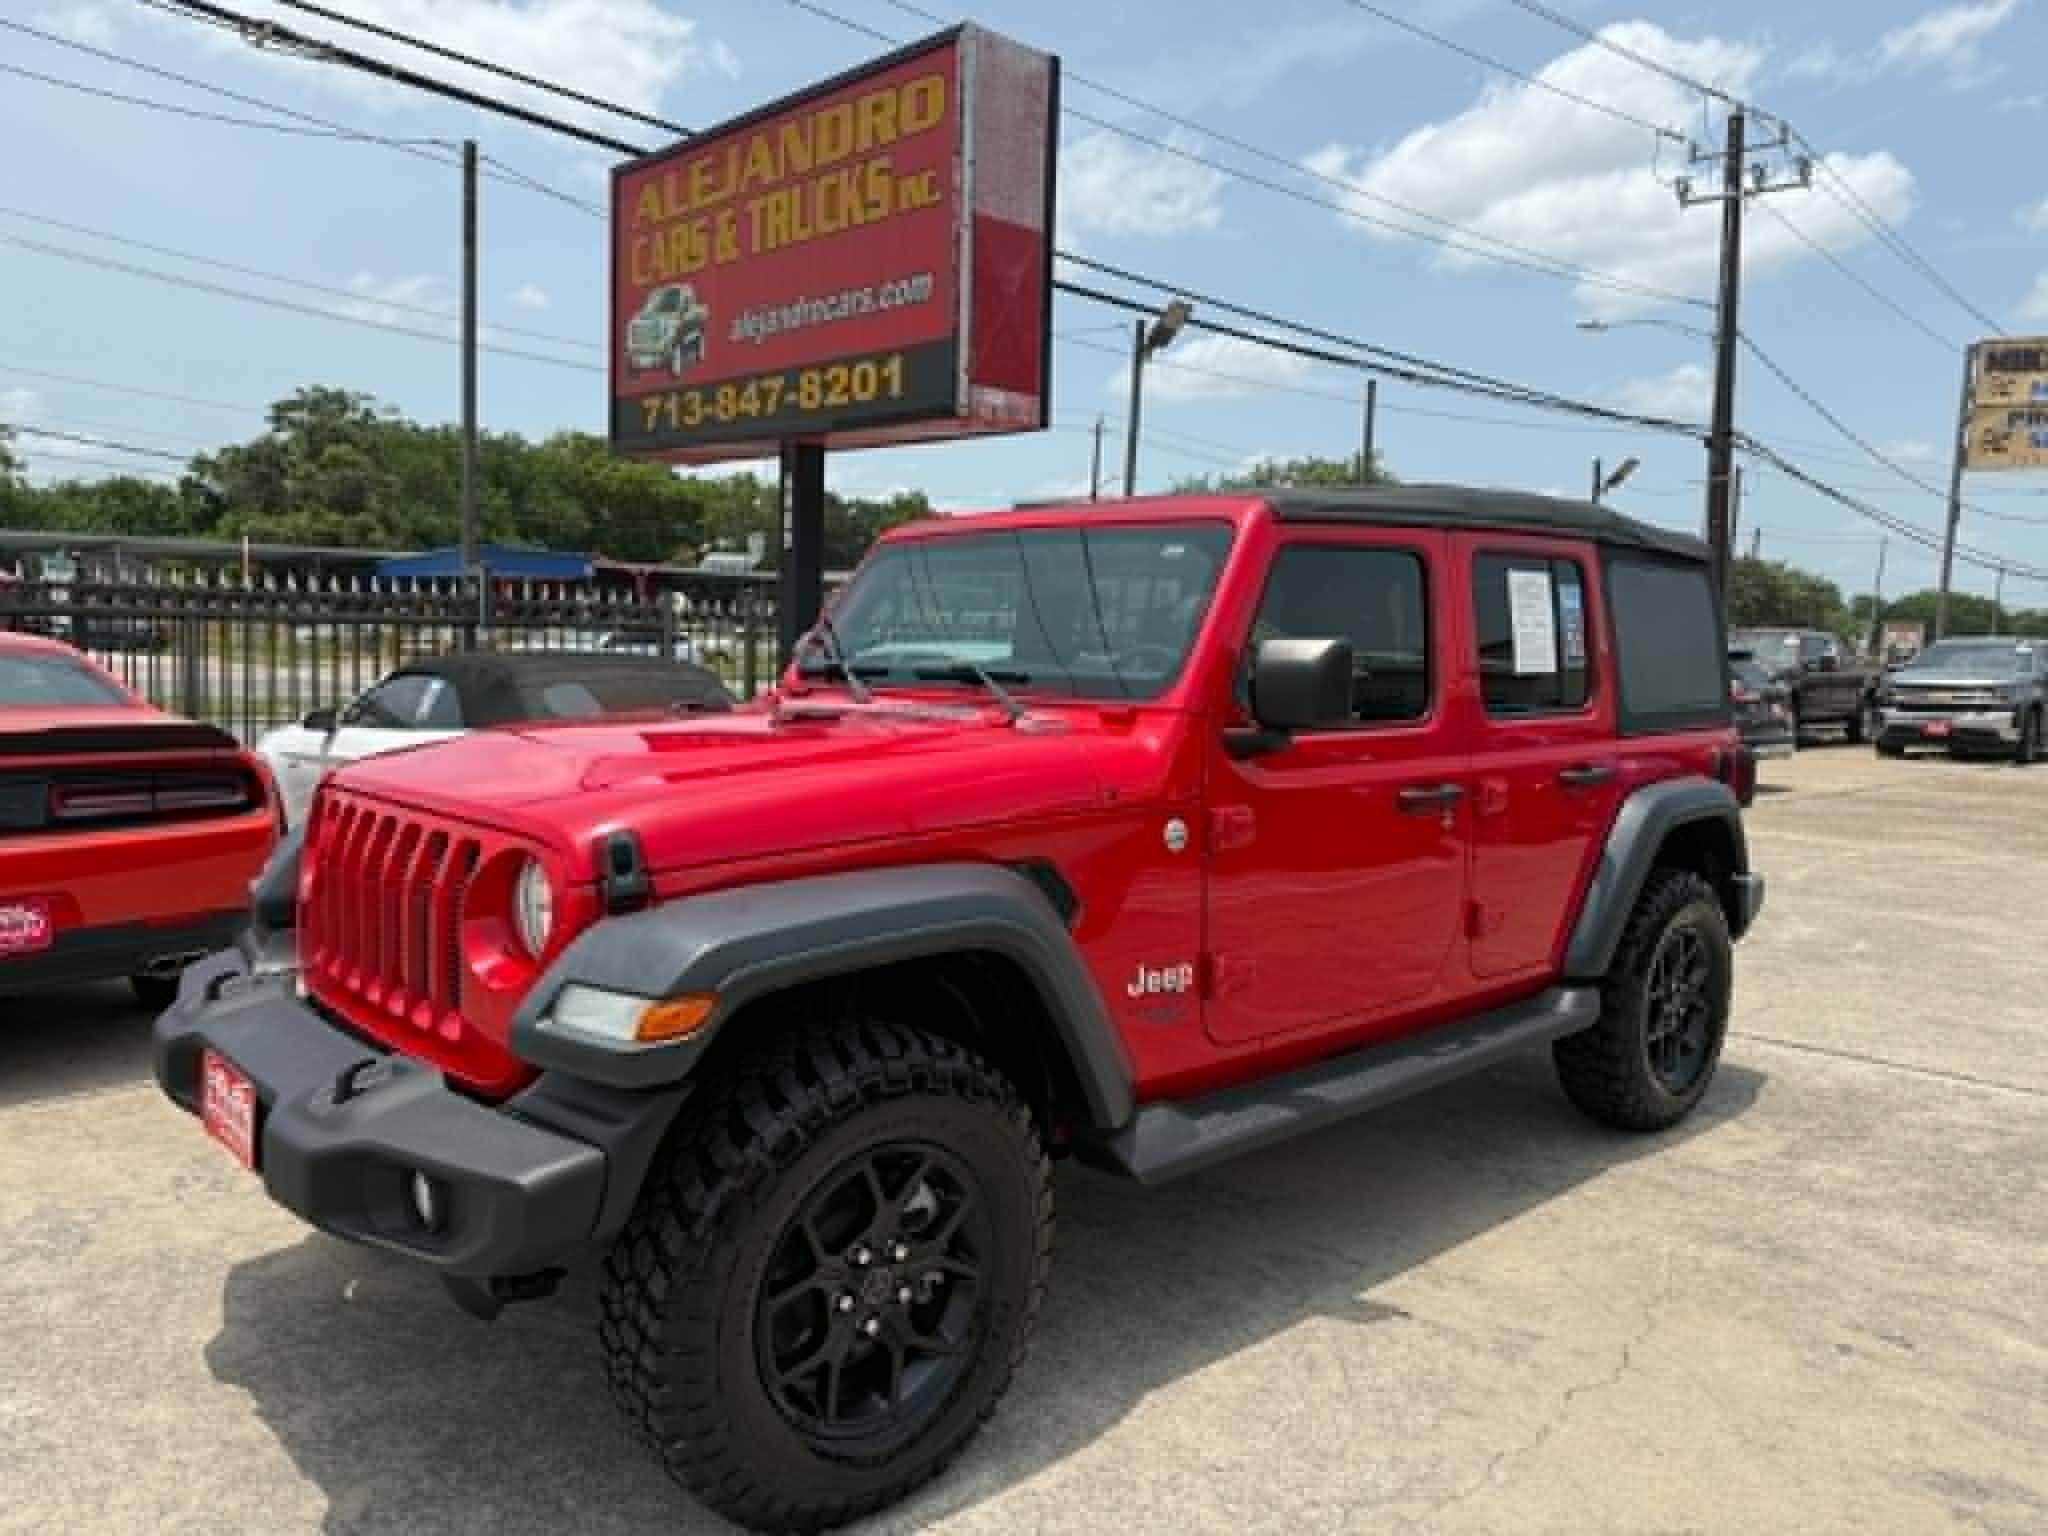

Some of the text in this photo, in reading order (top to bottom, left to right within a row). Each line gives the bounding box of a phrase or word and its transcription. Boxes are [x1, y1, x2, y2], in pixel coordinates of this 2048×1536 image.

[636, 73, 946, 223] ALEJANDRO
[630, 220, 708, 287] CARS
[716, 210, 741, 265] &
[748, 158, 892, 255] TRUCKS
[728, 272, 934, 345] alejandrocars.com
[641, 354, 906, 433] 713-847-8201
[1127, 962, 1193, 998] Jeep
